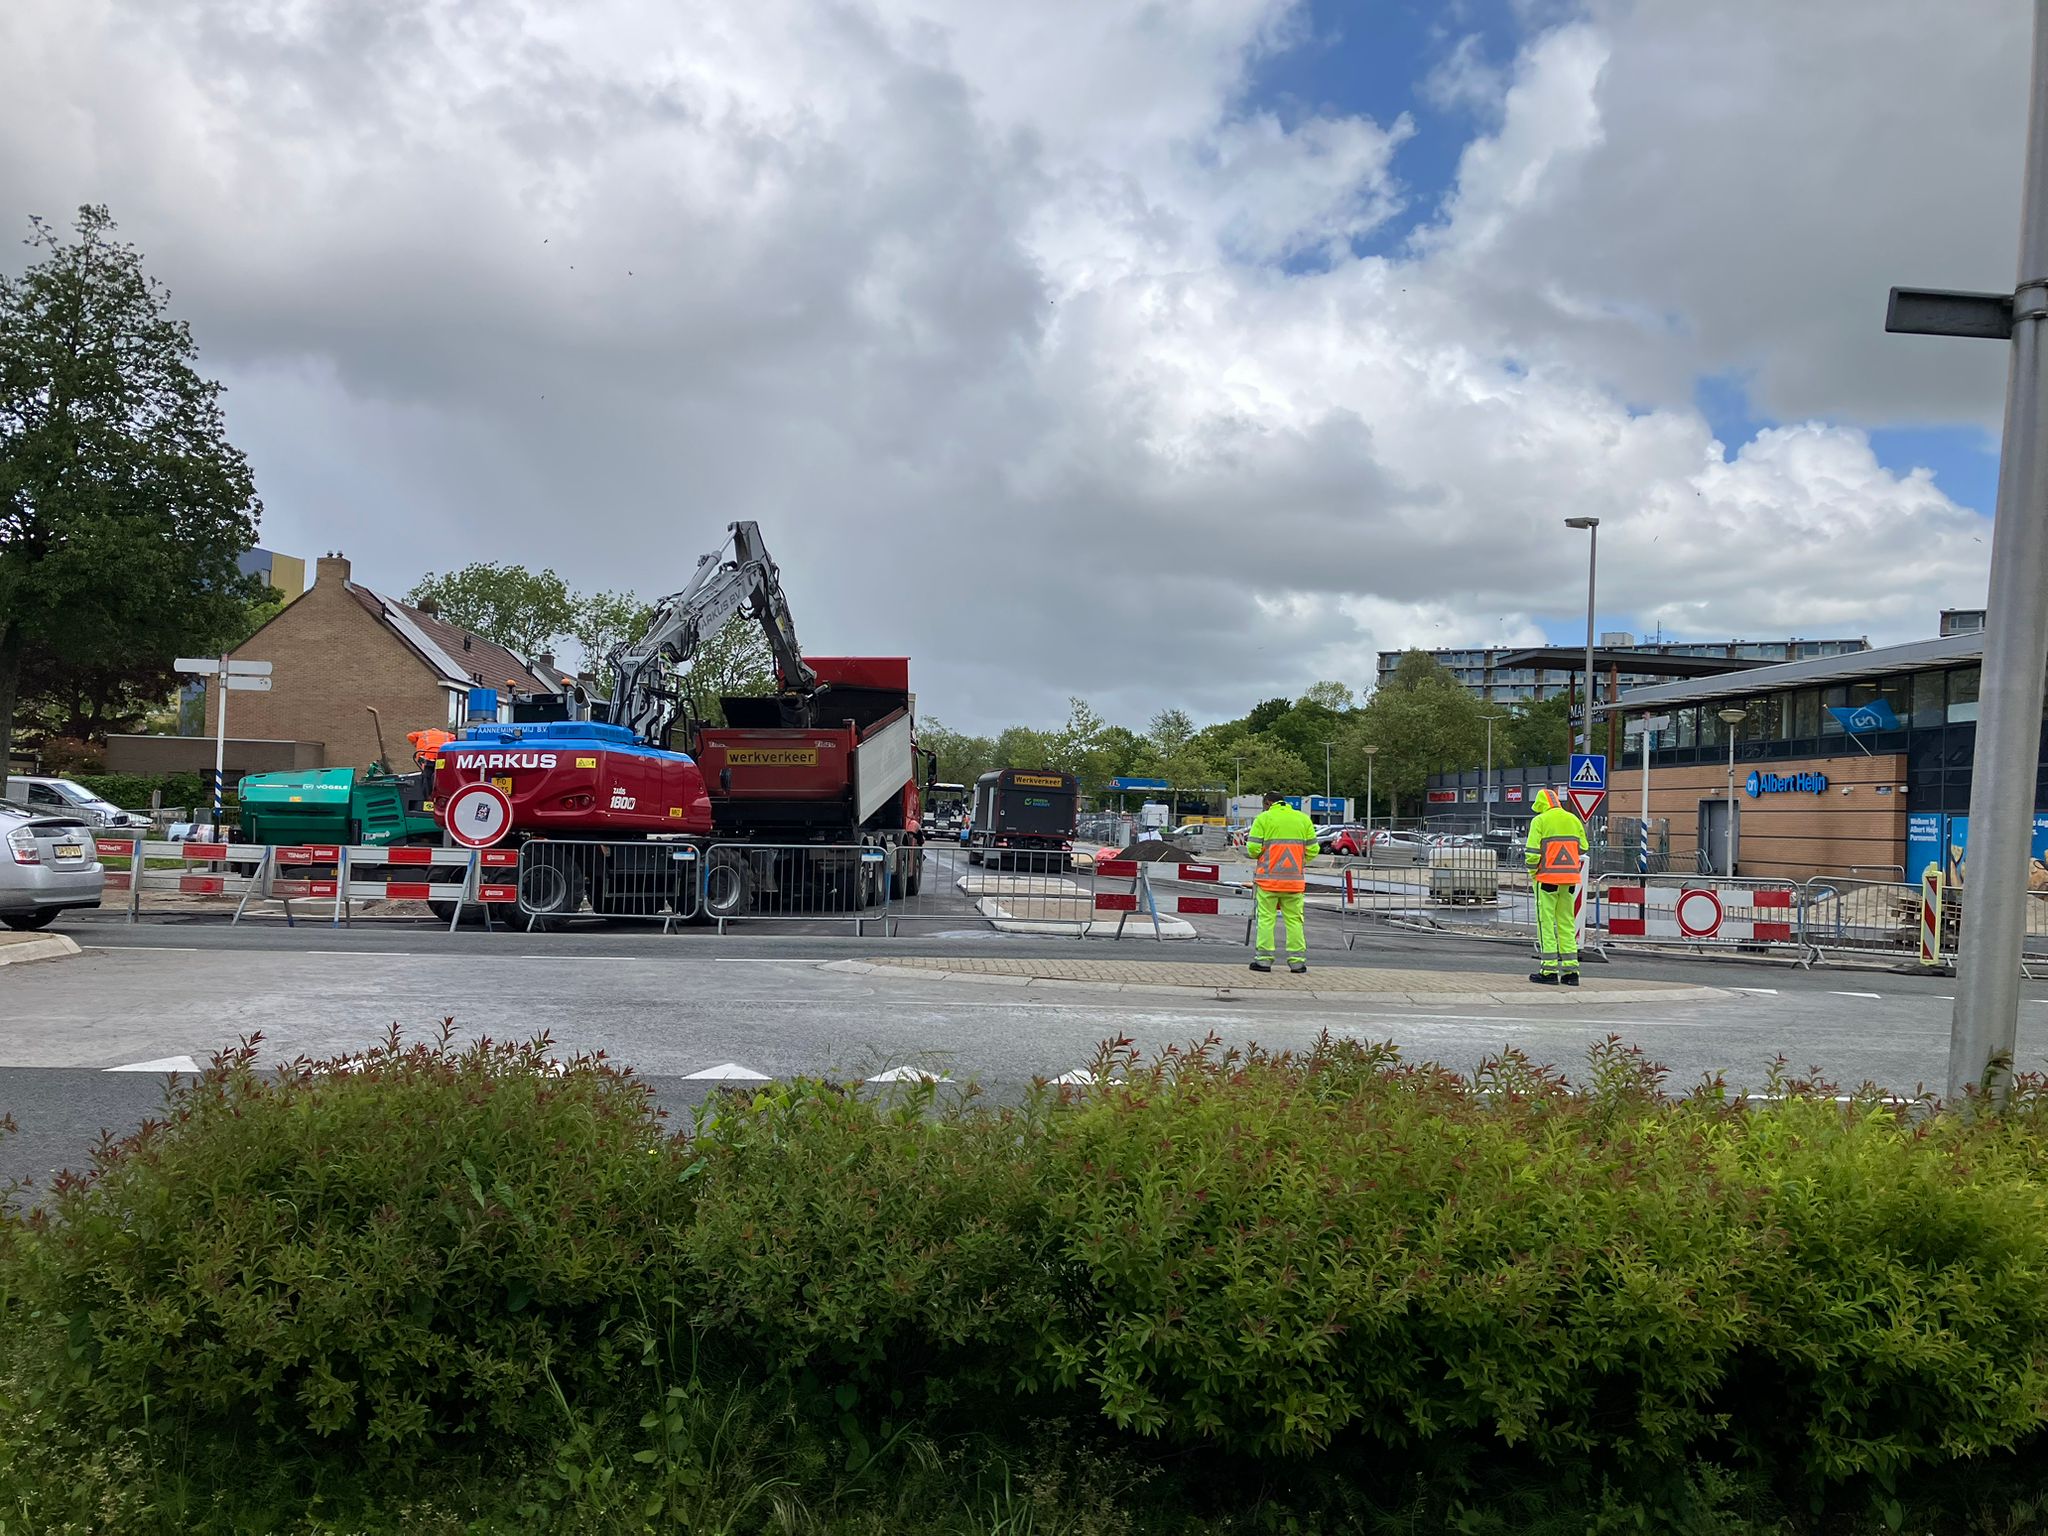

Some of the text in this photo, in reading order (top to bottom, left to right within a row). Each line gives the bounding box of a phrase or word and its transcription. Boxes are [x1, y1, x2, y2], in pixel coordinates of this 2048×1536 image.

[456, 753, 557, 769] MARKUS
[729, 751, 814, 763] werkverkeer
[1015, 776, 1061, 786] Werkverkeer
[1760, 774, 1795, 792] Albert
[1797, 772, 1827, 795] Heijn
[610, 796, 637, 810] 180W
